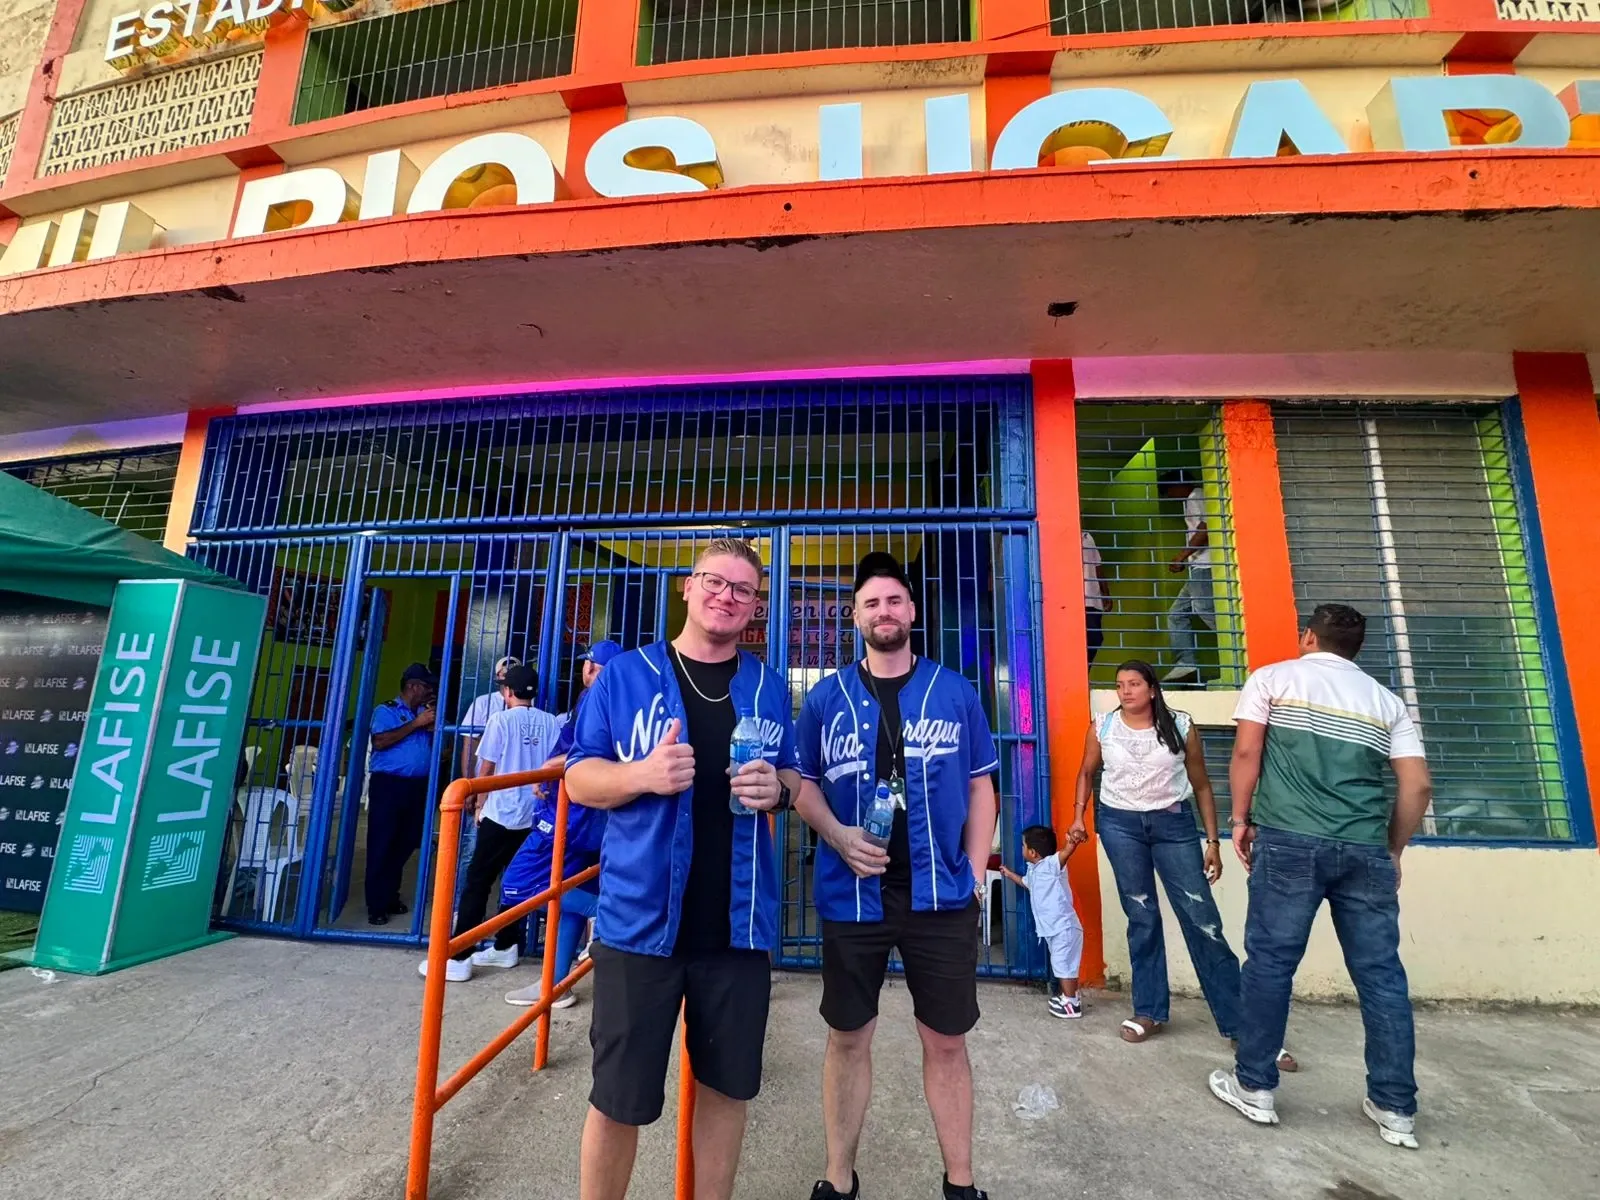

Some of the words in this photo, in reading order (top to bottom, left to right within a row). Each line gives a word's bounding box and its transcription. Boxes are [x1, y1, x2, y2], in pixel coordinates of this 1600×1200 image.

[819, 75, 1600, 181] UGAR
[41, 677, 68, 688] LAFISE
[9, 709, 36, 721] LAFISE
[66, 710, 89, 721] LAFIS
[80, 633, 155, 825] LAFISE
[157, 636, 241, 823] LAFISE
[32, 743, 59, 754] LAFISE
[0, 775, 26, 787] LAFISE
[22, 810, 50, 822] LAFISE
[13, 880, 42, 893] LAFISE
